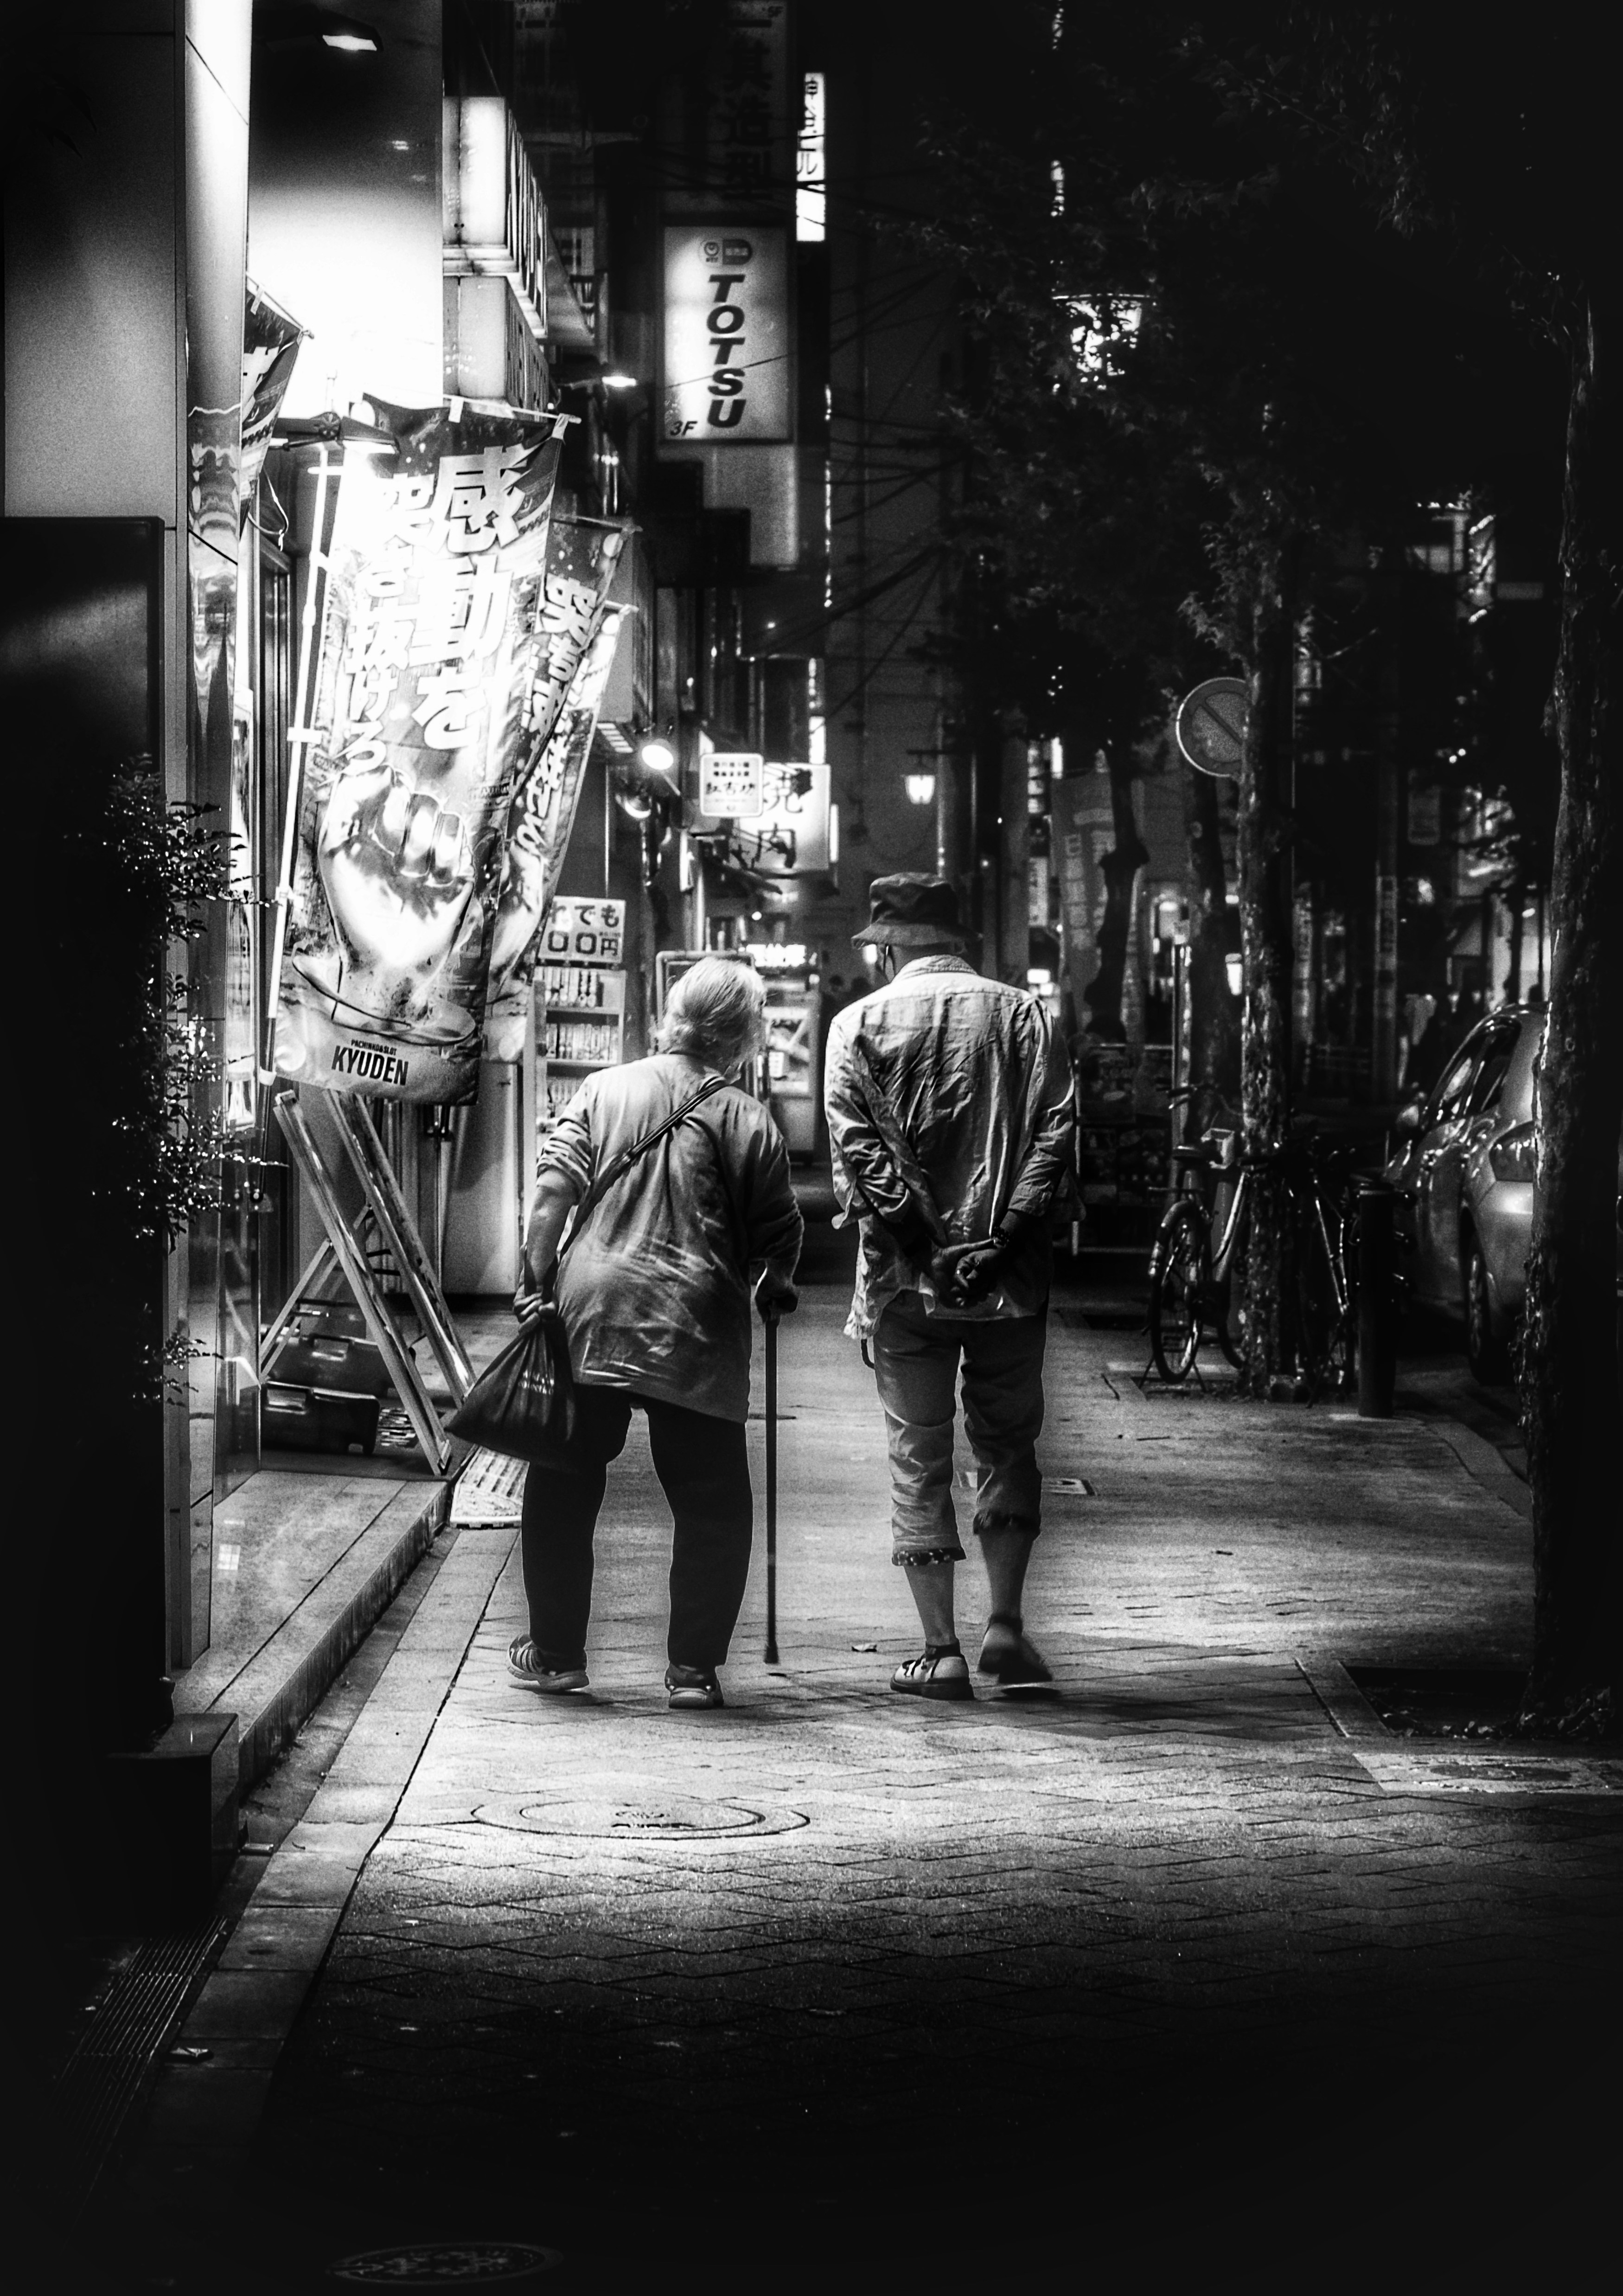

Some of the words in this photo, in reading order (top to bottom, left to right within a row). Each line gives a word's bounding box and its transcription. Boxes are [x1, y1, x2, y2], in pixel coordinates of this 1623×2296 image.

[706, 274, 746, 428] TOTSU
[670, 420, 697, 436] 3F
[409, 444, 529, 750] 感動を
[331, 1045, 409, 1086] KYUDEN
[351, 1039, 397, 1056] PACHINKO&SLOT
